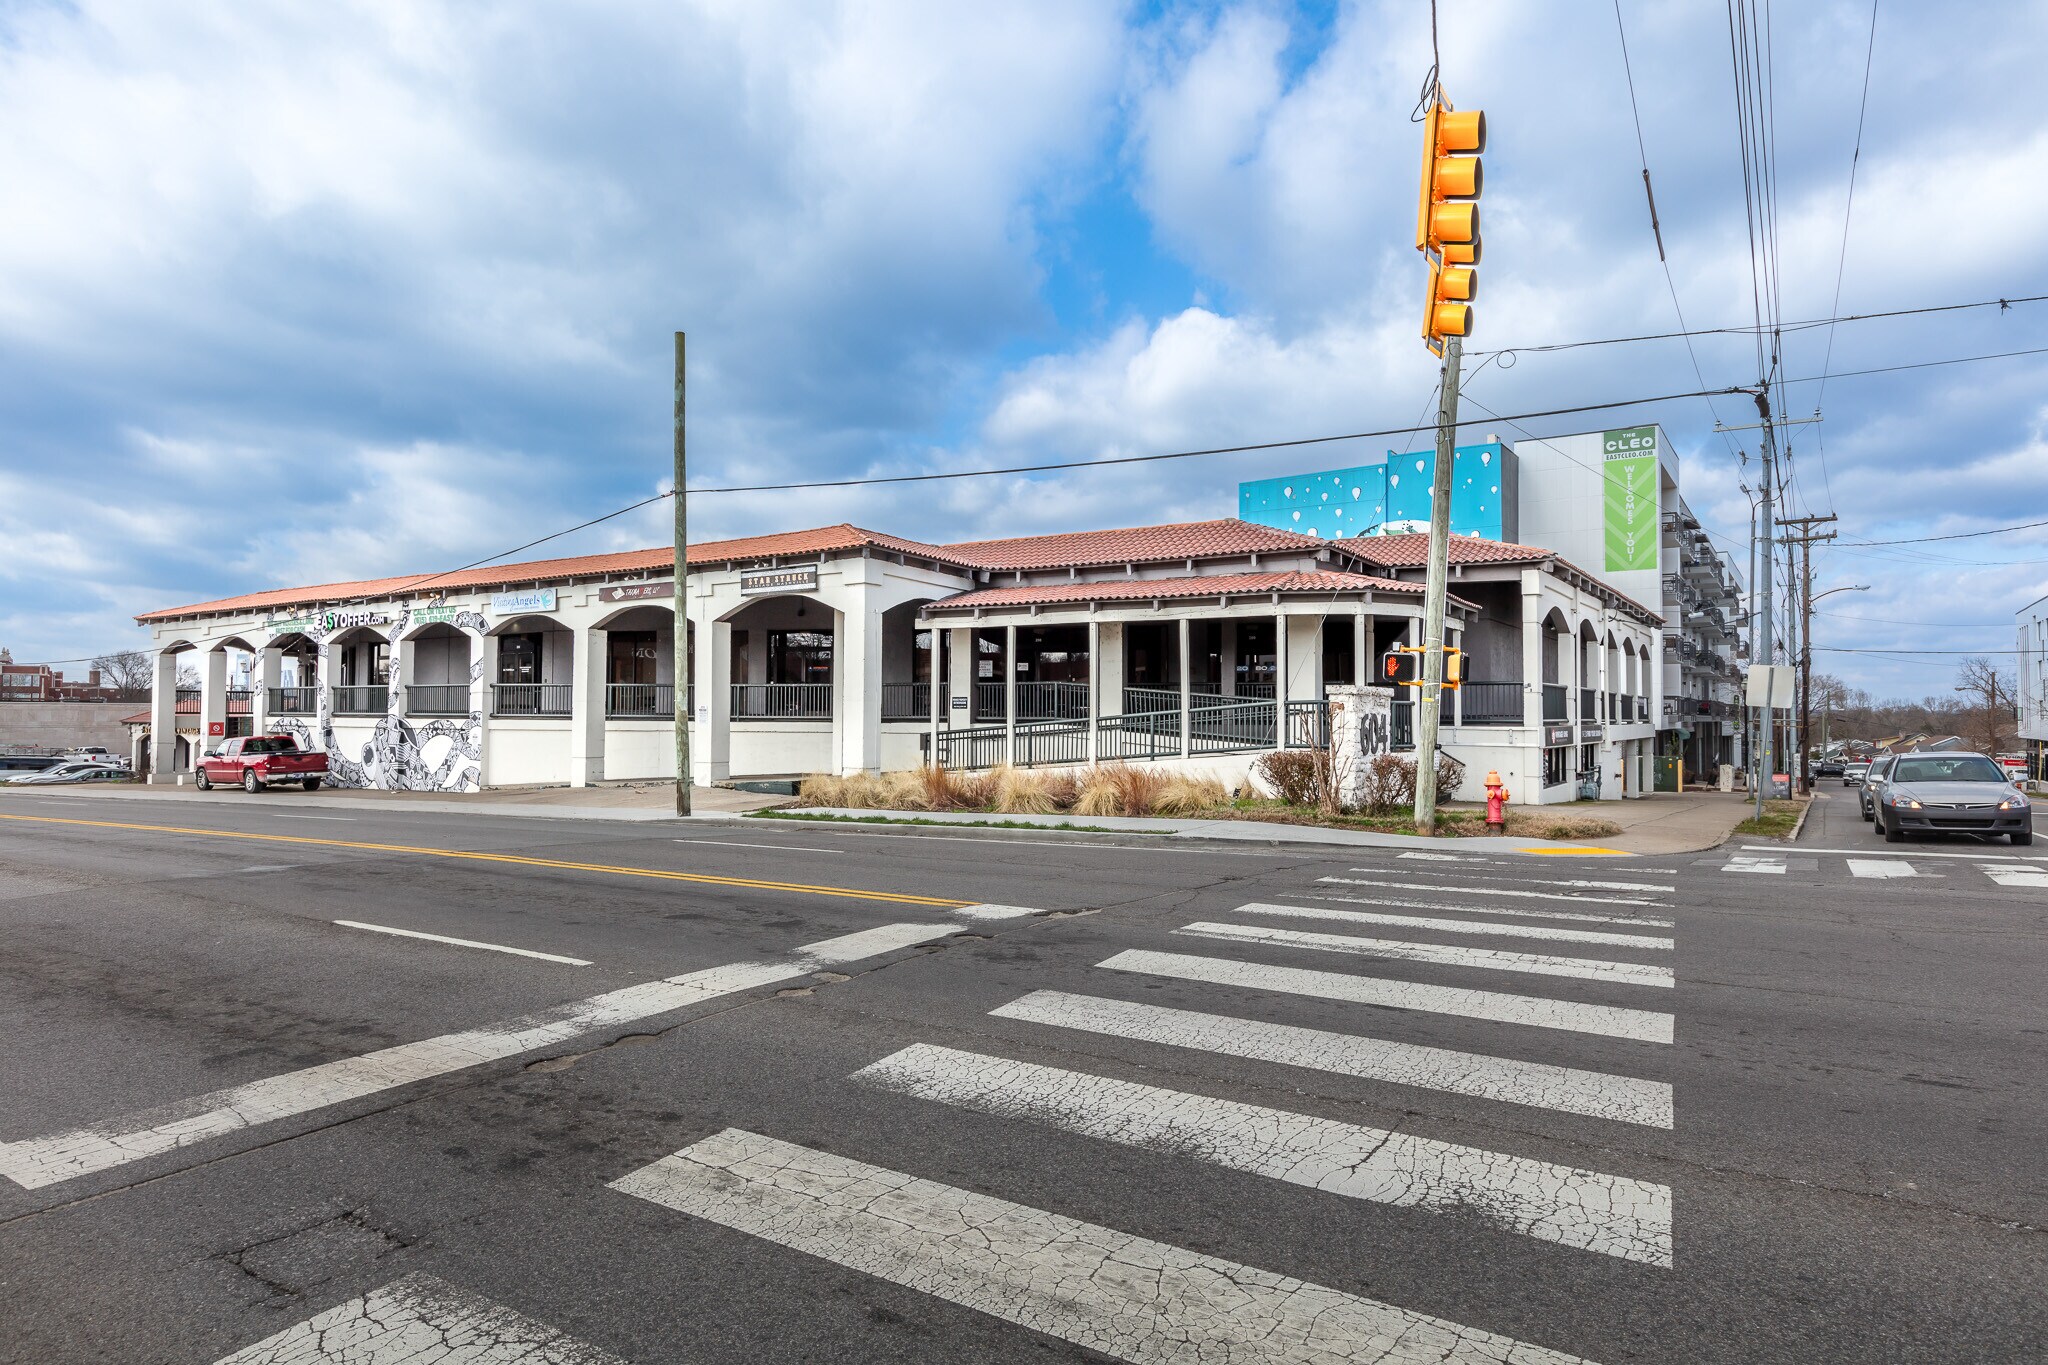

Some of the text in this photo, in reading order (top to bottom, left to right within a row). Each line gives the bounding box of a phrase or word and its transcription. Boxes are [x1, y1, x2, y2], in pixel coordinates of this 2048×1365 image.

[1606, 437, 1653, 451] CLEO
[1606, 450, 1653, 460] EASTCLEO.COM
[1624, 465, 1635, 561] WELCOMES YOU!
[748, 573, 809, 586] STAR STRUCK
[1360, 712, 1389, 756] 604
